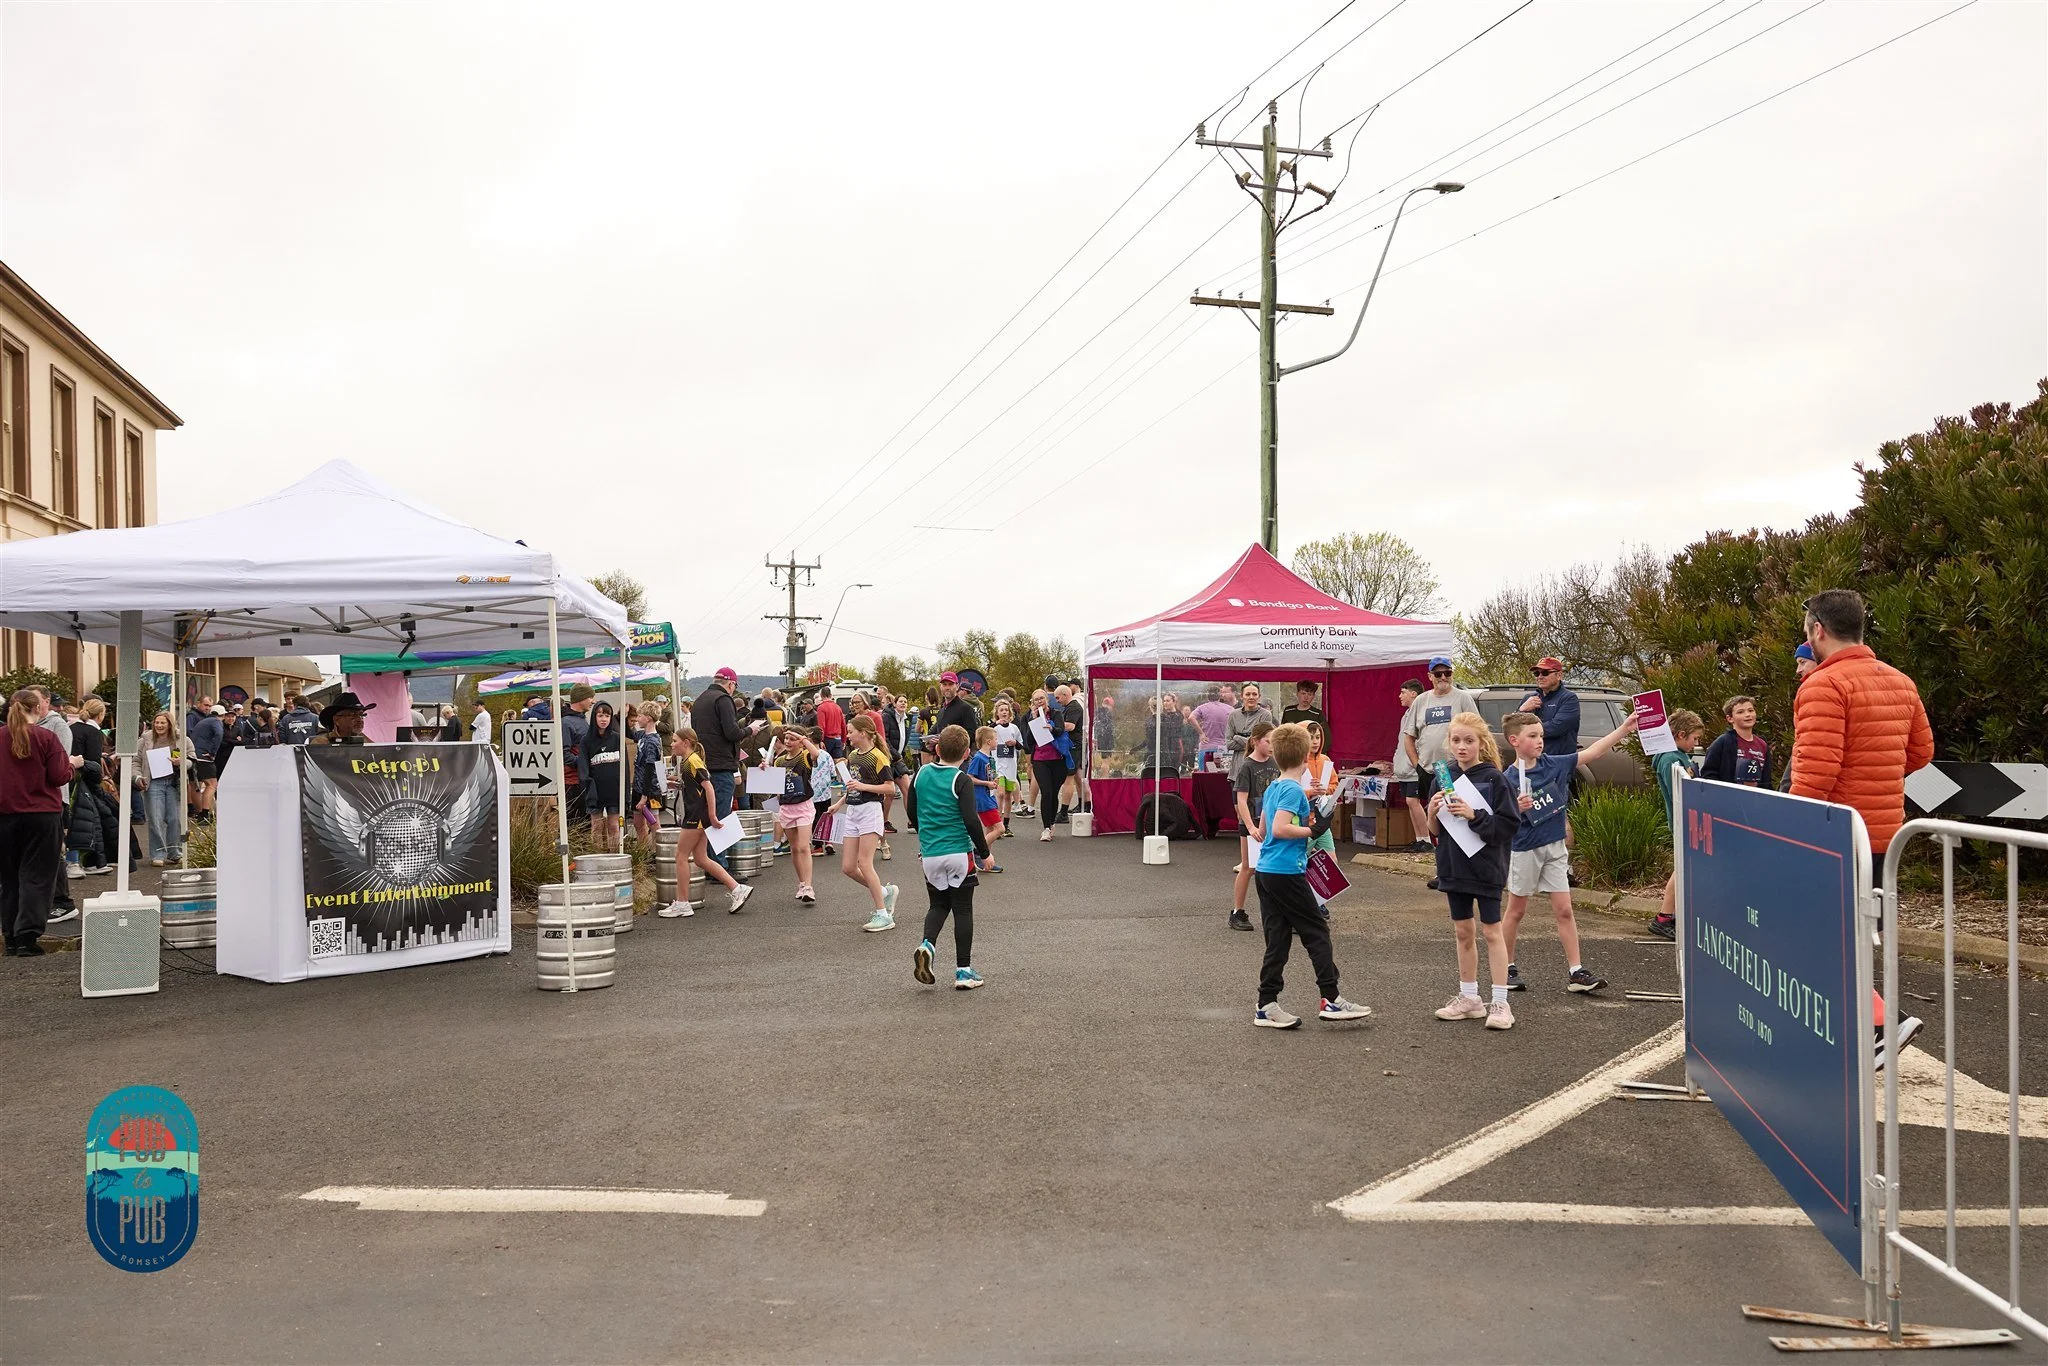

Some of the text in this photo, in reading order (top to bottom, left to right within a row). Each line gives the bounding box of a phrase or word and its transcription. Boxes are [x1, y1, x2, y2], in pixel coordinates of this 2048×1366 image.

[1248, 599, 1341, 612] Bendigo Bank
[1260, 625, 1358, 639] Community Bank
[1107, 635, 1137, 653] Bendigo Bank
[1264, 640, 1355, 652] Lancefield & Romsey
[512, 728, 551, 746] ONE
[509, 751, 553, 769] WAY
[1747, 765, 1758, 774] 75
[786, 782, 795, 790] 23
[1533, 793, 1554, 811] 814
[306, 878, 493, 909] Event Entertainment
[1746, 906, 1759, 928] THE
[1696, 916, 1835, 1046] LANCEFIELD HOTEL
[1757, 1020, 1773, 1046] 1870
